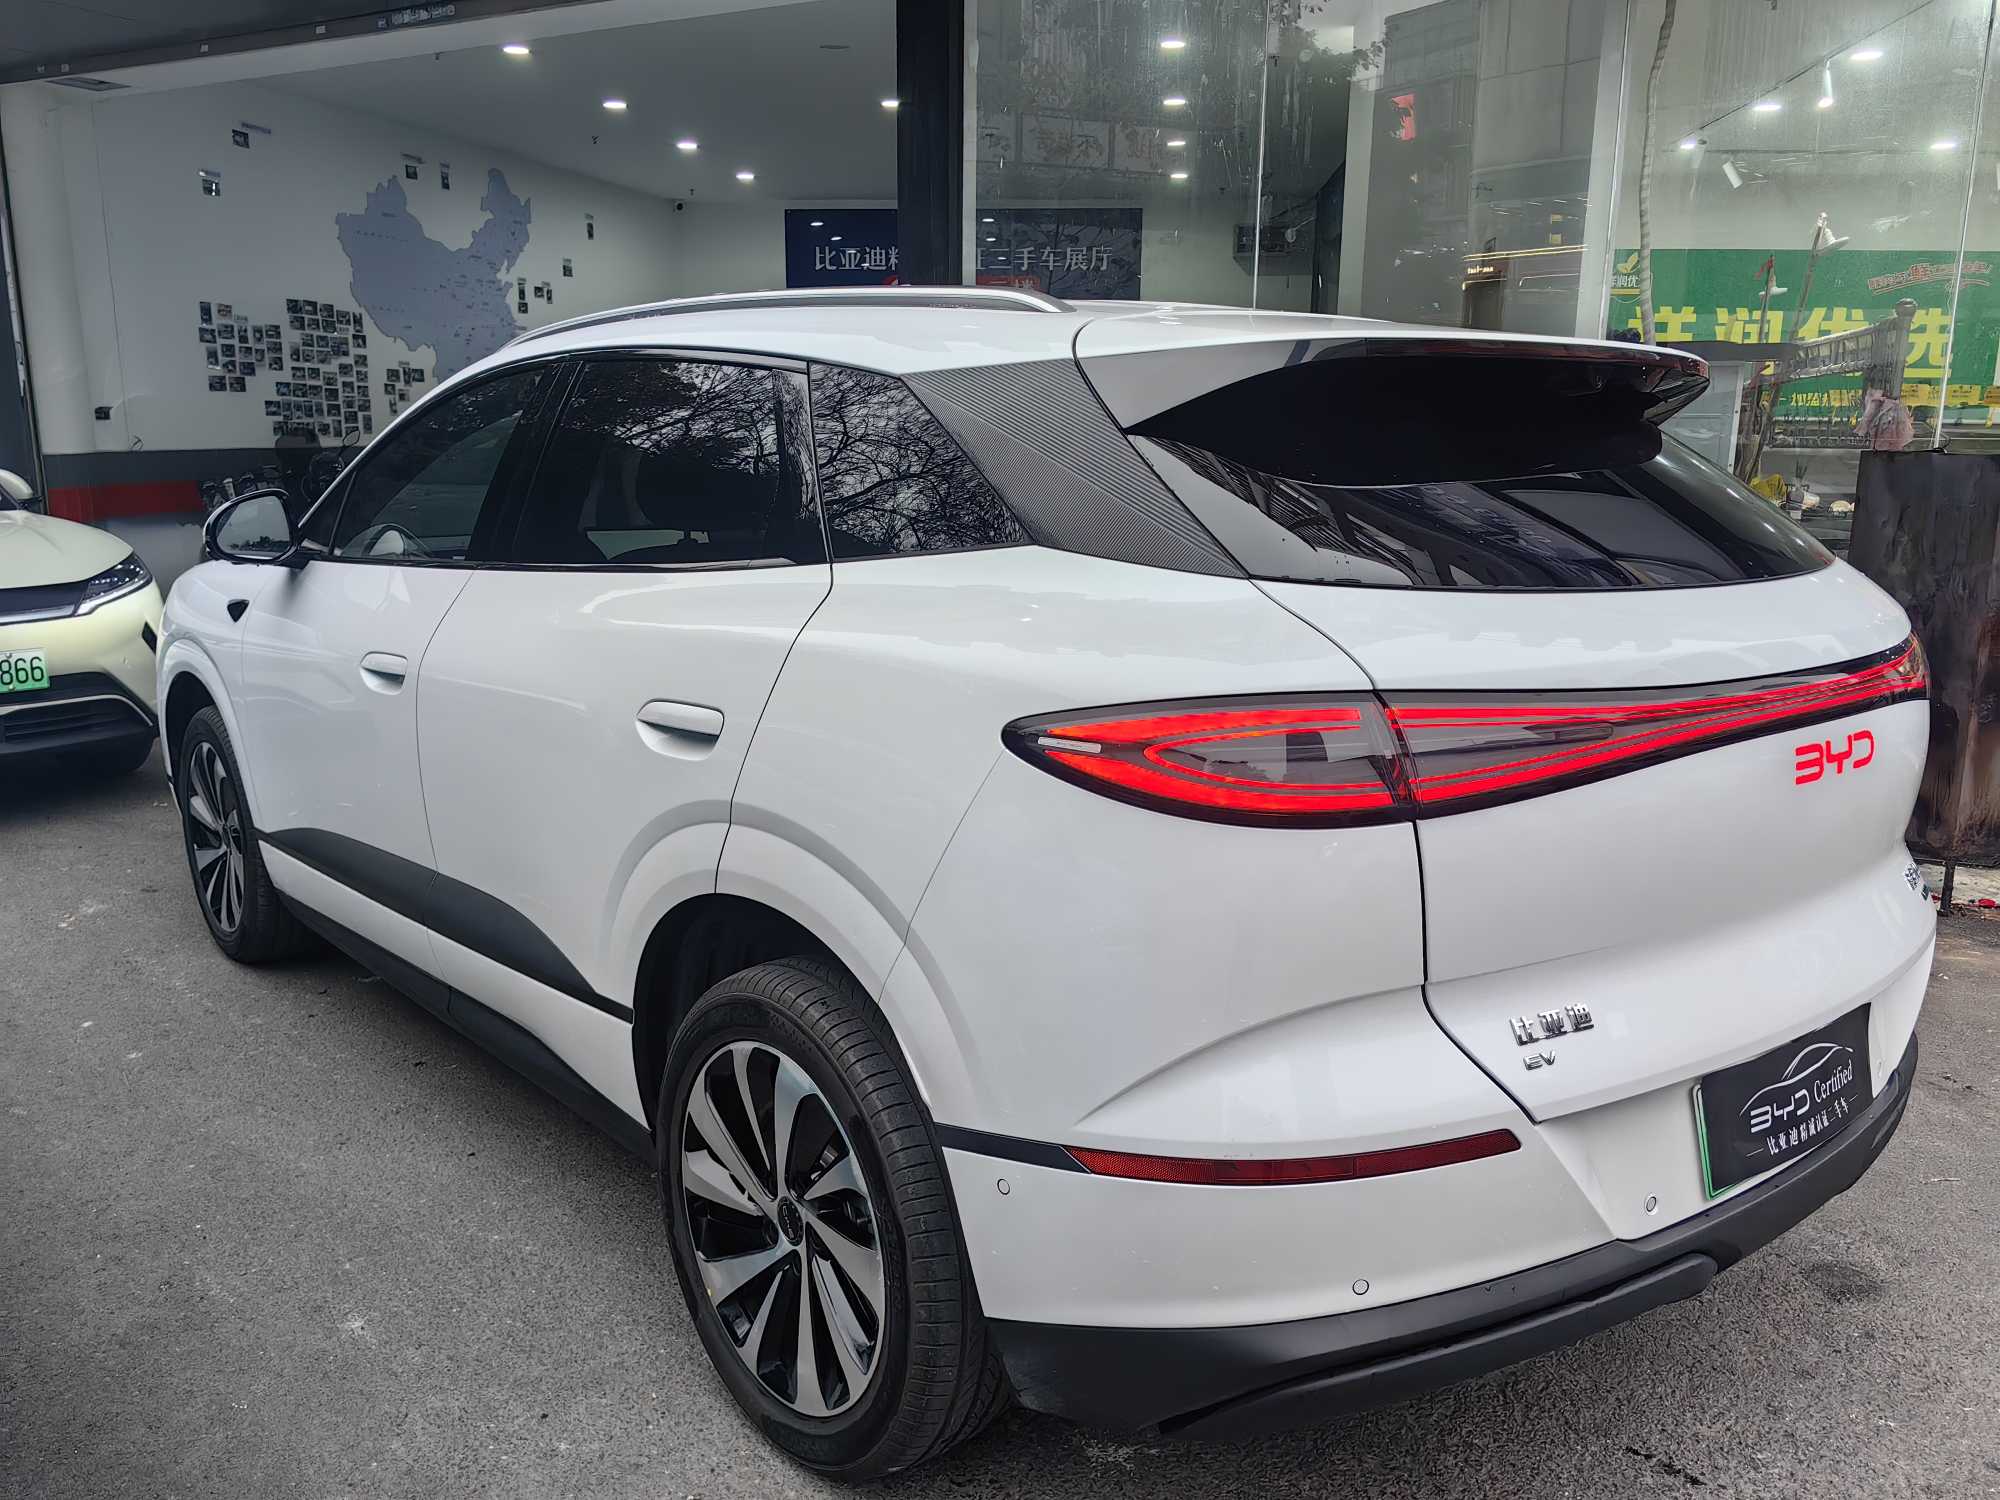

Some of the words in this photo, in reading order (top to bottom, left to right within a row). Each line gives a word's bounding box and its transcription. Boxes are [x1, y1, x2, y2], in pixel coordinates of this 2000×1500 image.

[0, 656, 44, 686] 866
[1795, 729, 1875, 785] BYD
[1509, 1002, 1595, 1046] 比亚迪
[1523, 1050, 1556, 1071] EV
[1750, 1088, 1810, 1134] BYD
[1813, 1058, 1853, 1103] Certified
